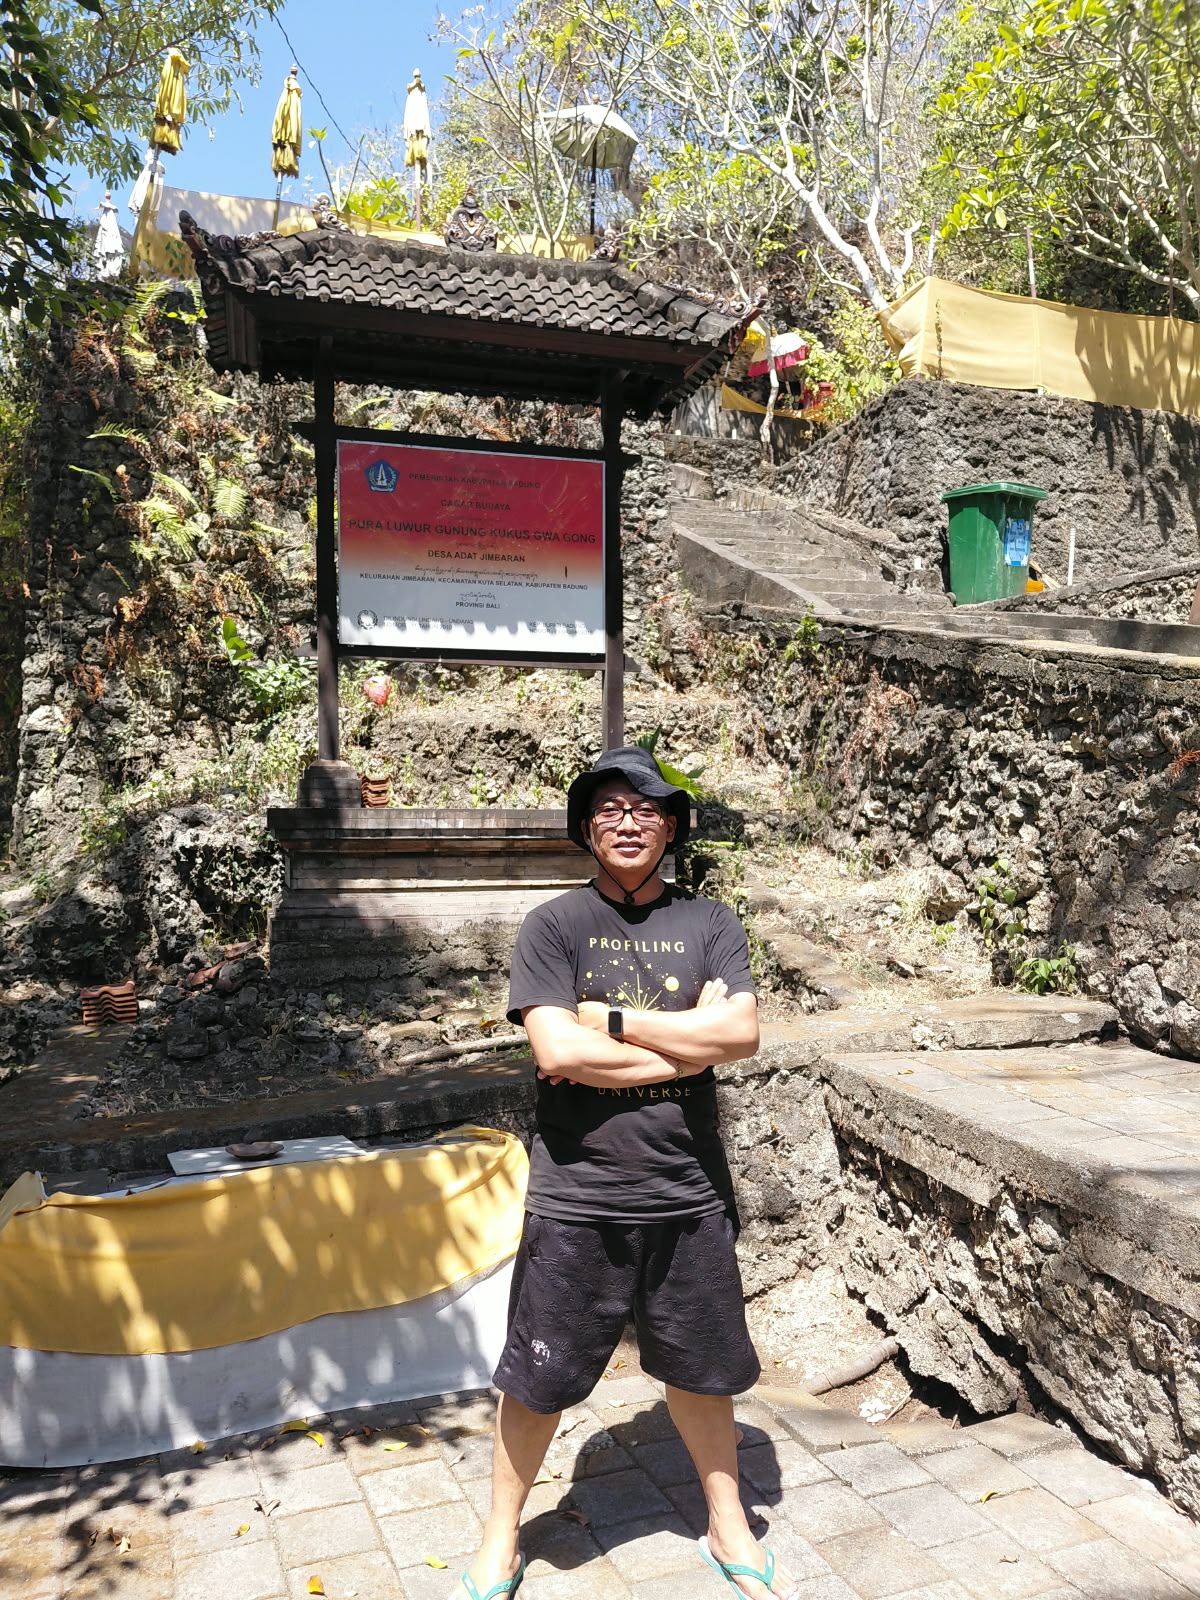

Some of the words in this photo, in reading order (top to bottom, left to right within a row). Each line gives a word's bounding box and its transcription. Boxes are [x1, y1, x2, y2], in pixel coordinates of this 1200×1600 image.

[508, 480, 541, 489] BADUNG
[440, 499, 472, 508] CAGAR
[475, 501, 511, 511] BUDAYA
[349, 519, 382, 529] PURA
[386, 521, 431, 534] LUWUR
[434, 524, 486, 537] GUNUNG
[490, 528, 530, 540] KUKUS
[533, 531, 560, 542] GWA
[563, 533, 596, 544] GONG
[427, 549, 452, 559] DESA
[454, 551, 478, 560] ADAT
[479, 552, 526, 562] JIMBARAN
[359, 573, 401, 581] KELURAHAN
[402, 575, 436, 583] JIMBARAN,
[438, 577, 477, 585] KECAMATAN
[455, 601, 485, 609] PROVINSI
[589, 936, 685, 953] PROFILING
[598, 1086, 691, 1099] UNIVERSE
